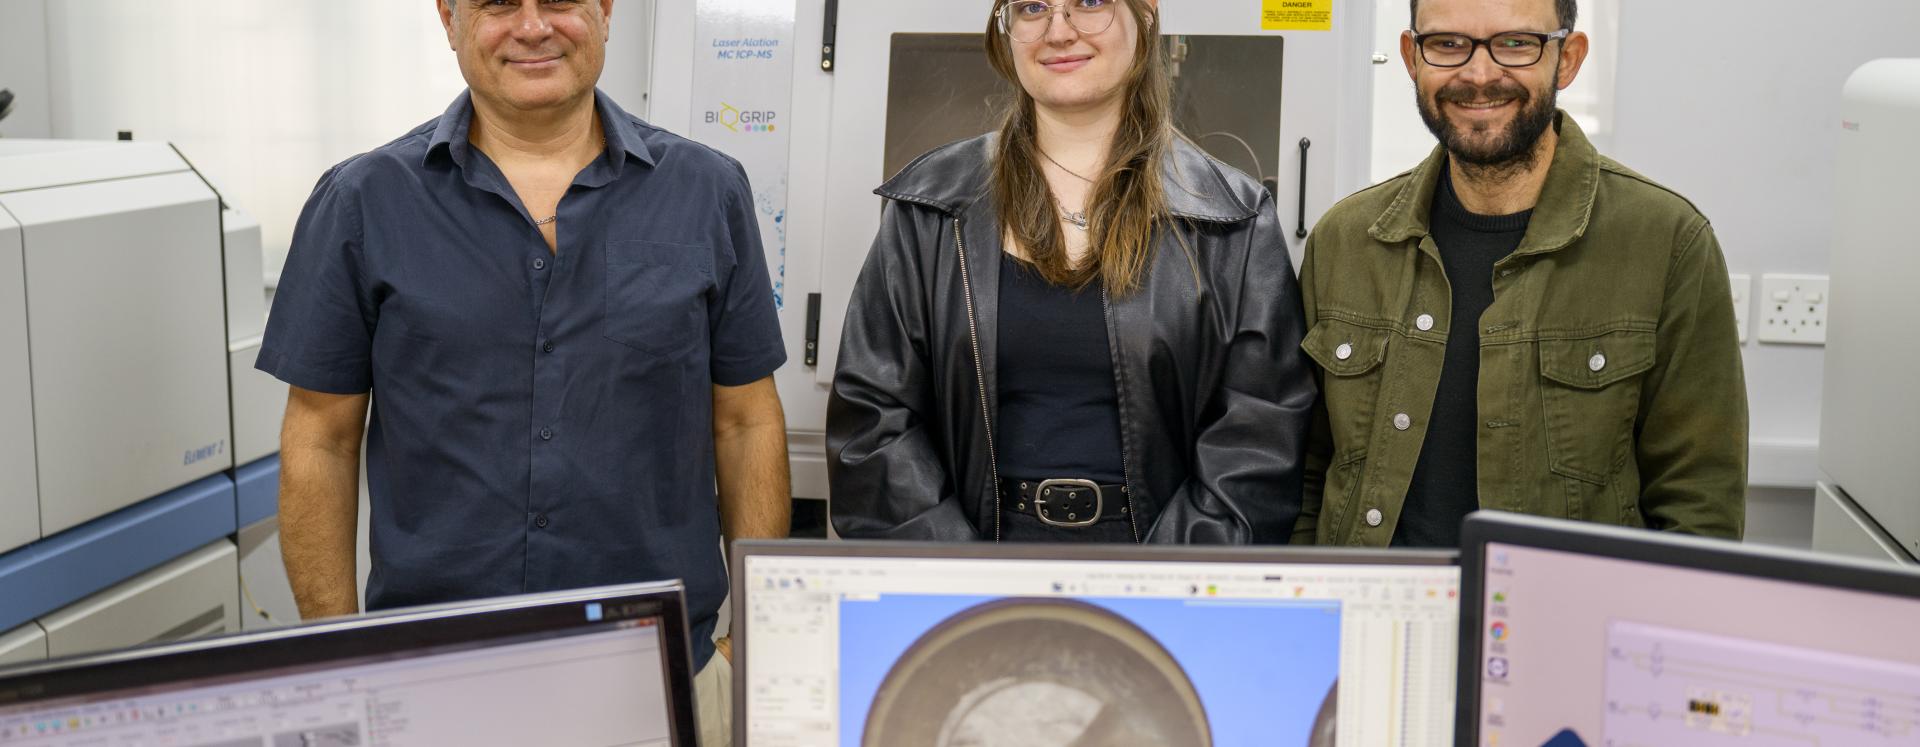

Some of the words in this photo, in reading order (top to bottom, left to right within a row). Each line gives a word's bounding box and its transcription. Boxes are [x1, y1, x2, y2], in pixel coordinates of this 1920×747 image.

[712, 39, 739, 47] Laser
[717, 50, 733, 59] MC
[735, 50, 773, 59] ICP-MS
